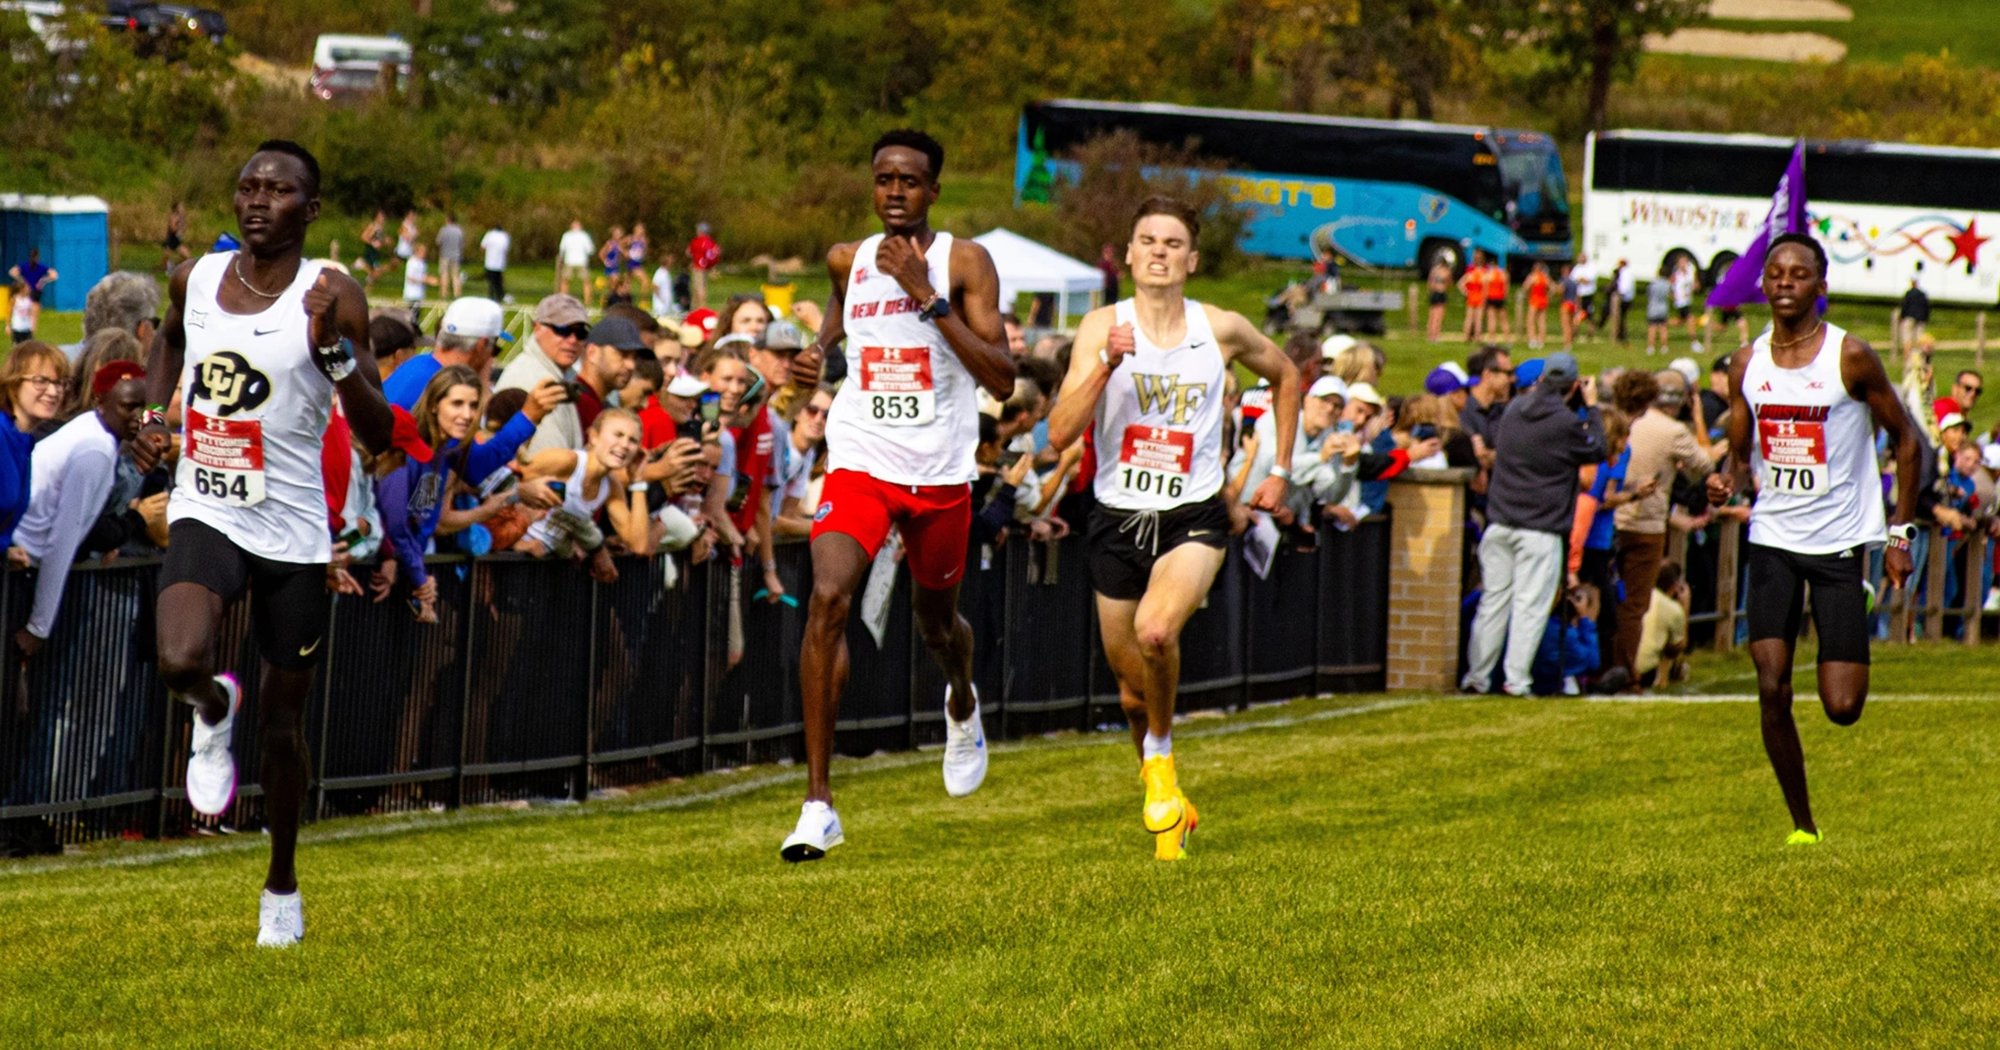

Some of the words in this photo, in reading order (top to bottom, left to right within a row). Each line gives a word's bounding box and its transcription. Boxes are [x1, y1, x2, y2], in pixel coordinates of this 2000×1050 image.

[202, 354, 247, 406] CU
[872, 396, 920, 419] 853
[1131, 372, 1207, 425] WF
[195, 467, 248, 501] 654
[1123, 468, 1183, 498] 1016
[1771, 466, 1815, 490] 770
